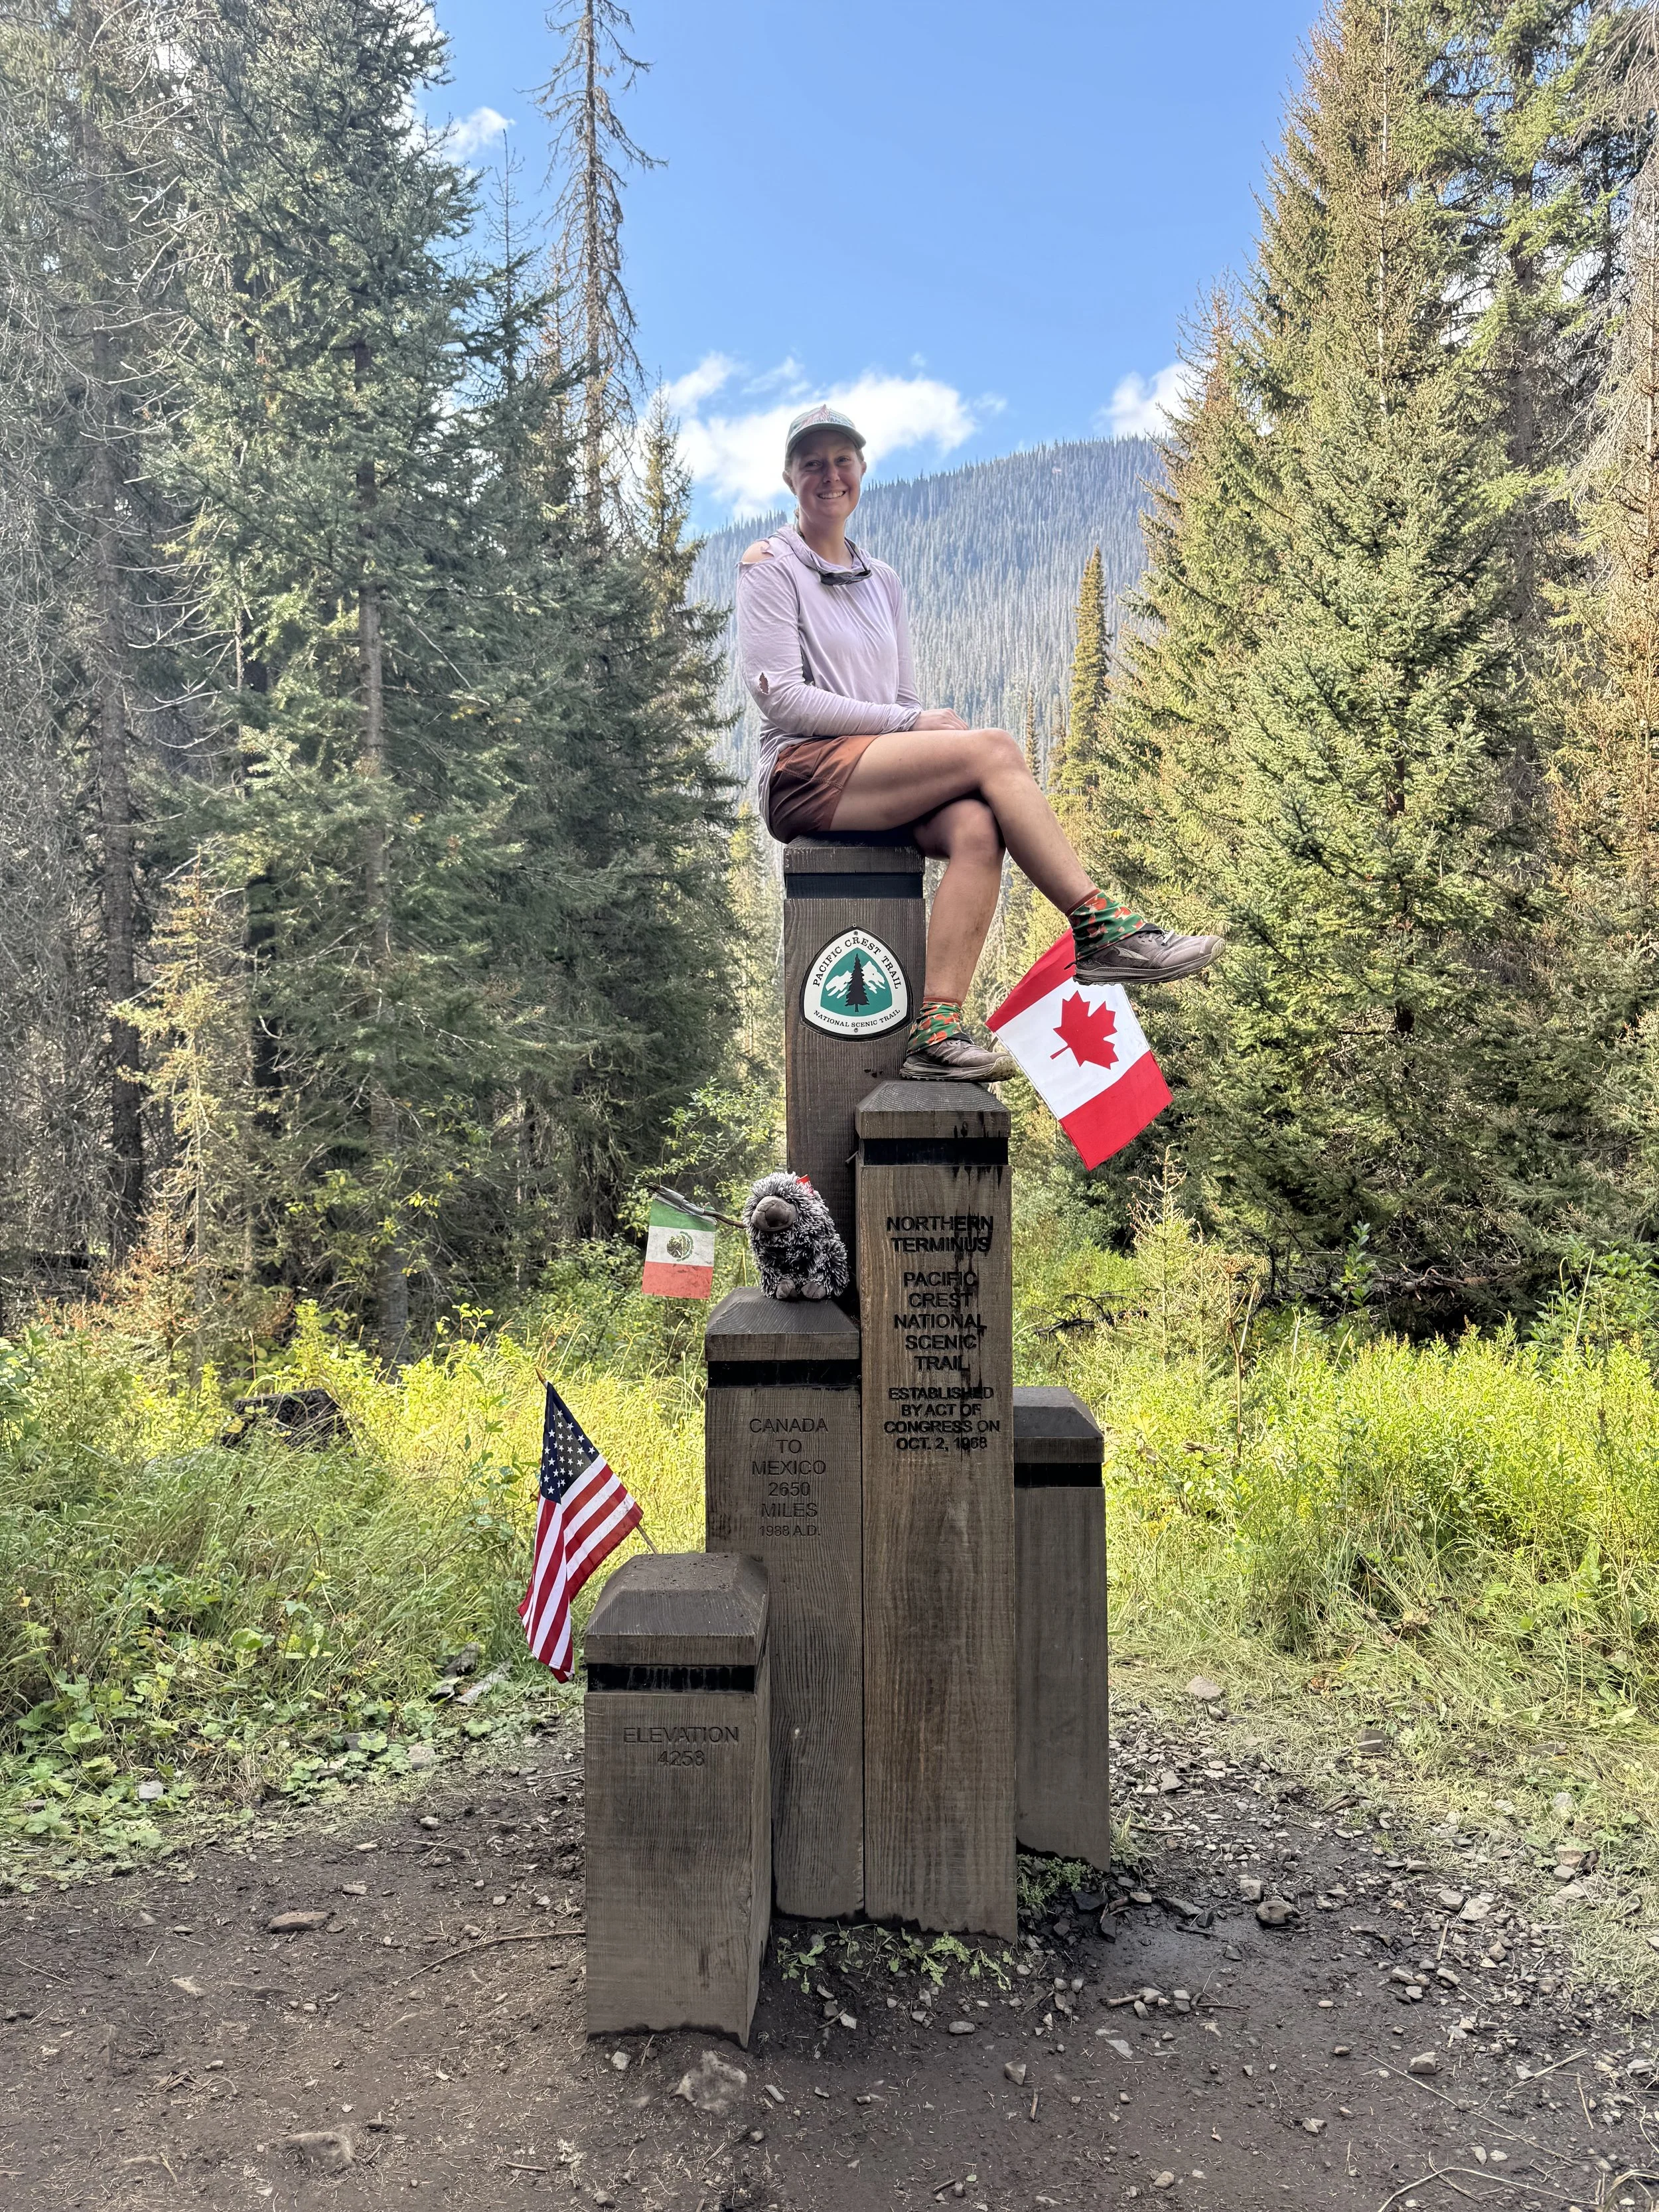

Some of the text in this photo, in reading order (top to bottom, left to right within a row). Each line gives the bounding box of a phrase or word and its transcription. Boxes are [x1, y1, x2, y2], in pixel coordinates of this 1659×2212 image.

[813, 936, 902, 989] PACIFIC CREST TRAIL
[814, 1009, 849, 1027] NATIONAL
[879, 1009, 901, 1023] TRAIL
[887, 1216, 993, 1232] NORTHERN
[891, 1237, 991, 1252] TERMINUS
[904, 1272, 977, 1288] PACIFIC
[908, 1293, 973, 1308] CREST
[895, 1313, 987, 1329] NATIONAL
[905, 1334, 977, 1350] SCENIC
[914, 1355, 970, 1371] TRAIL
[901, 1404, 982, 1418] BY ACT OF
[749, 1418, 829, 1433] CANADA
[884, 1420, 1000, 1434] CONGRESS ON
[776, 1439, 802, 1454] TO
[897, 1436, 987, 1452] OCT. 2, 1968
[752, 1460, 827, 1475] MEXICO
[768, 1482, 811, 1497] 2650
[761, 1503, 818, 1517] MILES
[759, 1525, 790, 1536] 1988
[623, 1726, 739, 1743] ELEVATION
[658, 1750, 705, 1767] 4258
